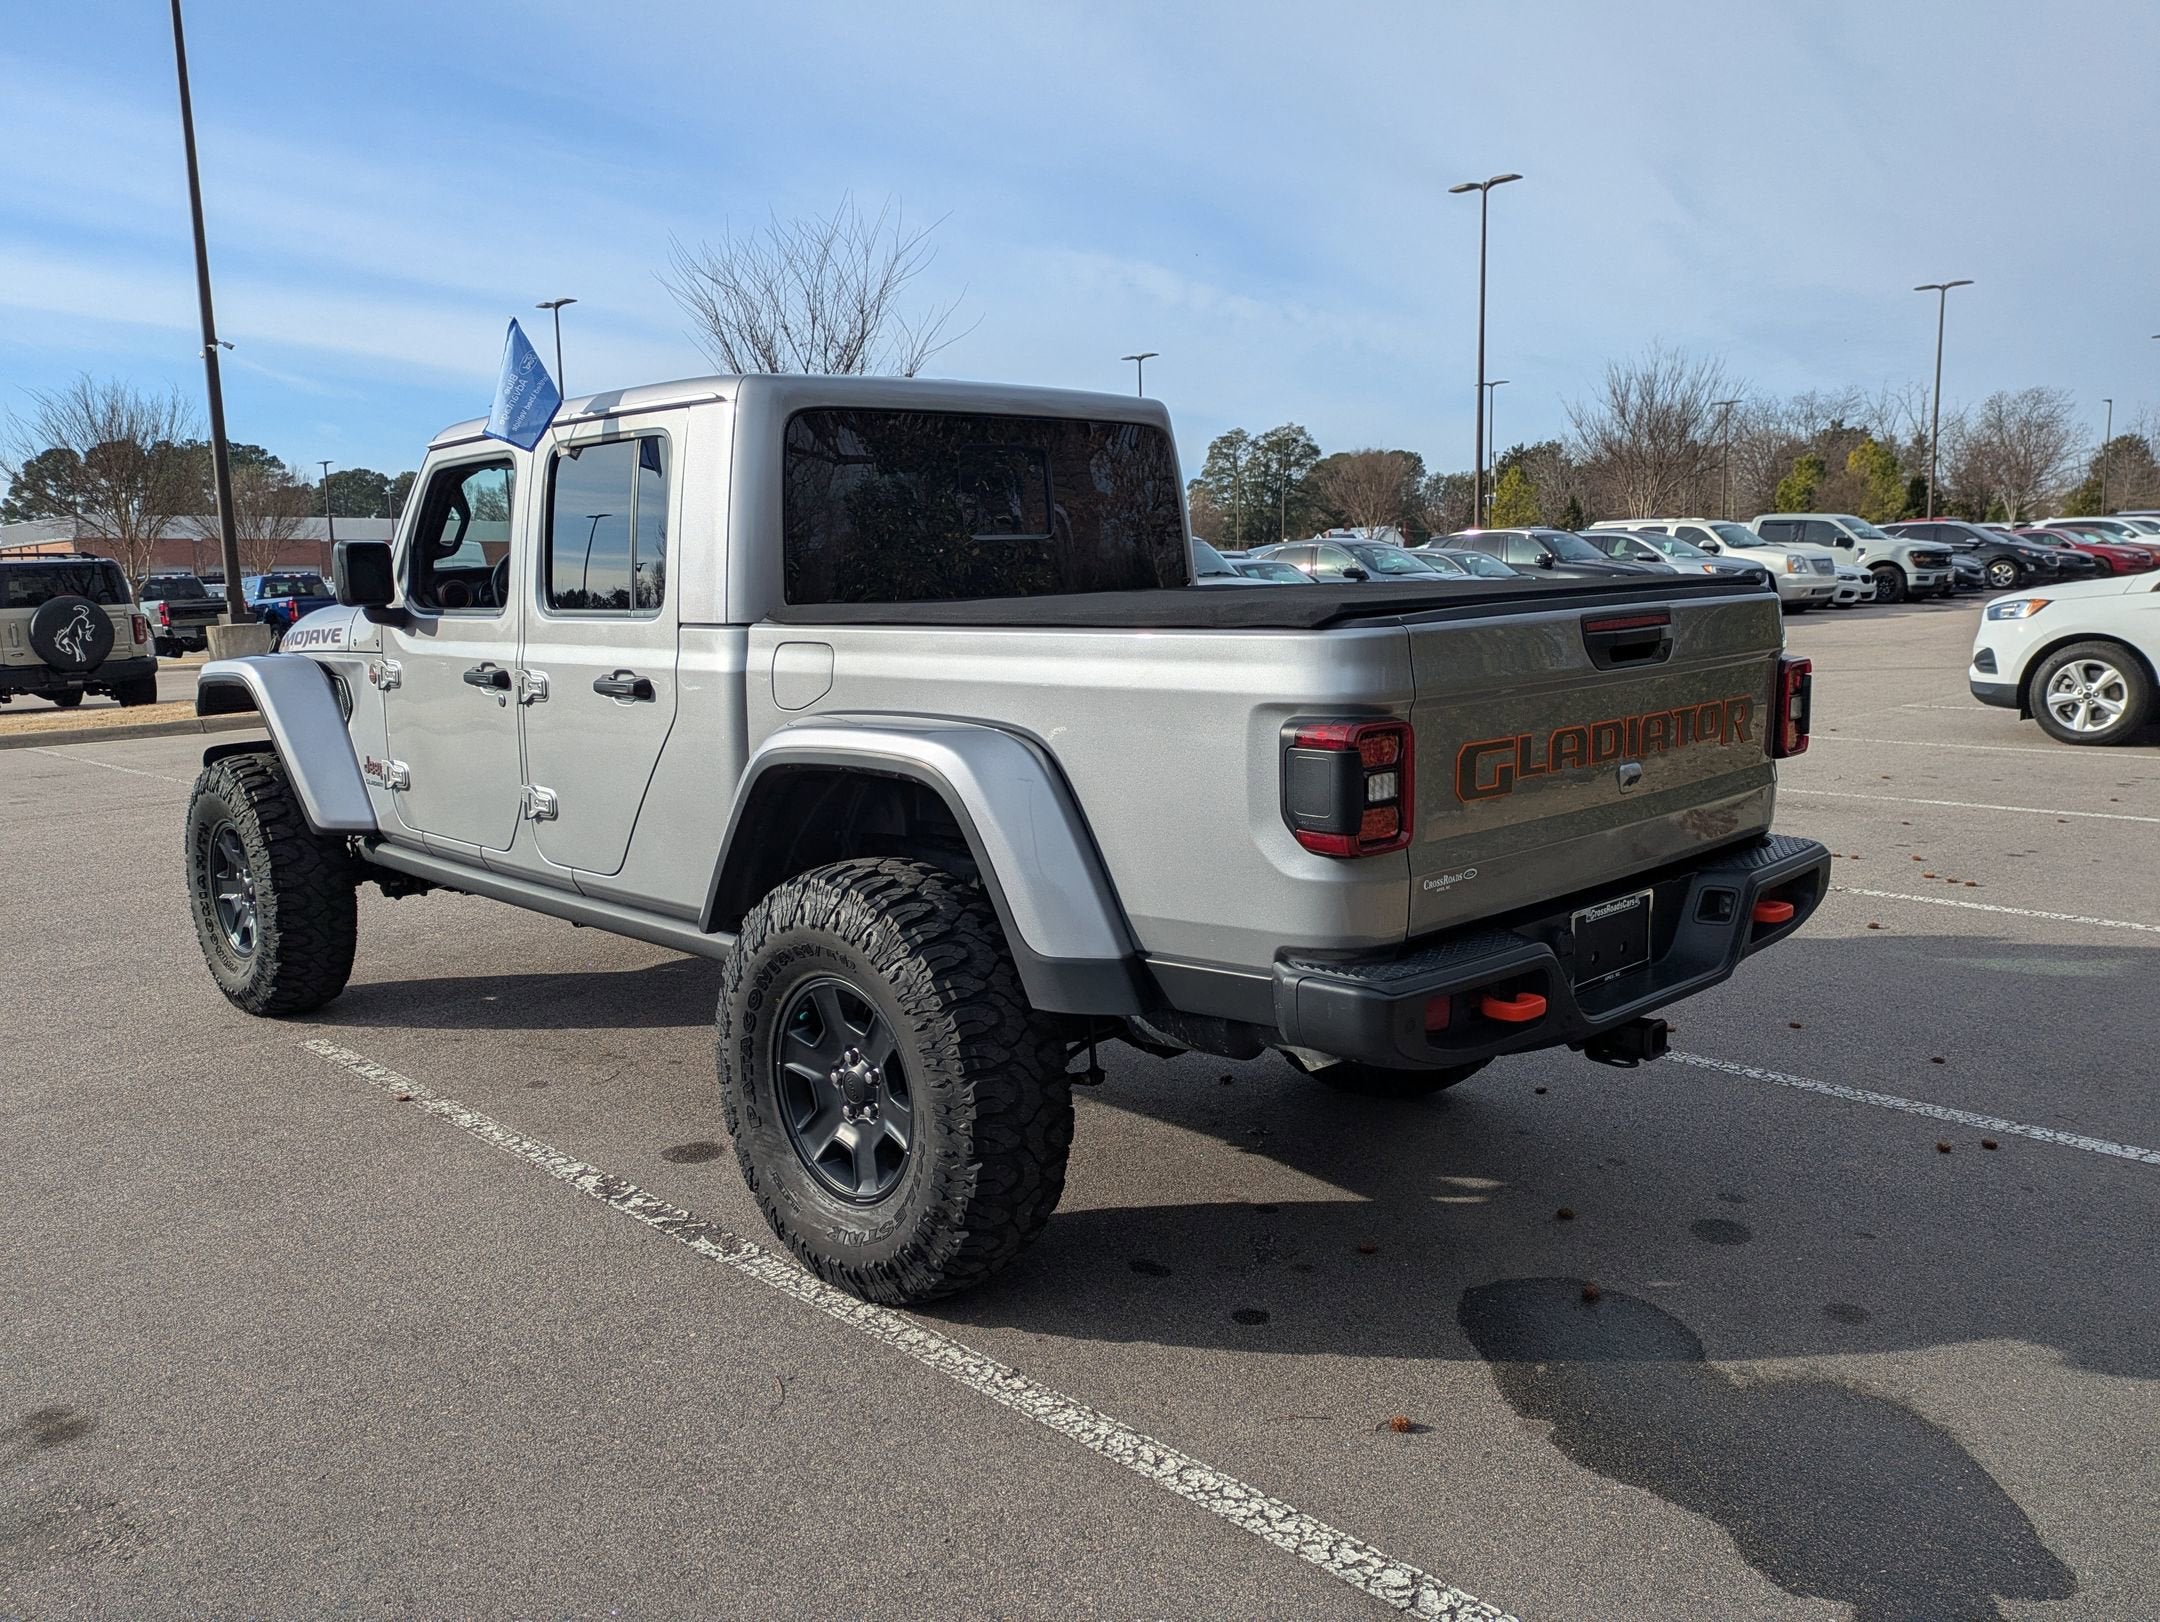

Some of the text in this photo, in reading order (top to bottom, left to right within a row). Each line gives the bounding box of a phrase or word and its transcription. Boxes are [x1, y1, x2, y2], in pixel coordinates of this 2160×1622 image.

[283, 627, 343, 649] MOJAVE
[1456, 695, 1754, 803] GLADIATOR
[740, 951, 795, 1129] PATAGONIA
